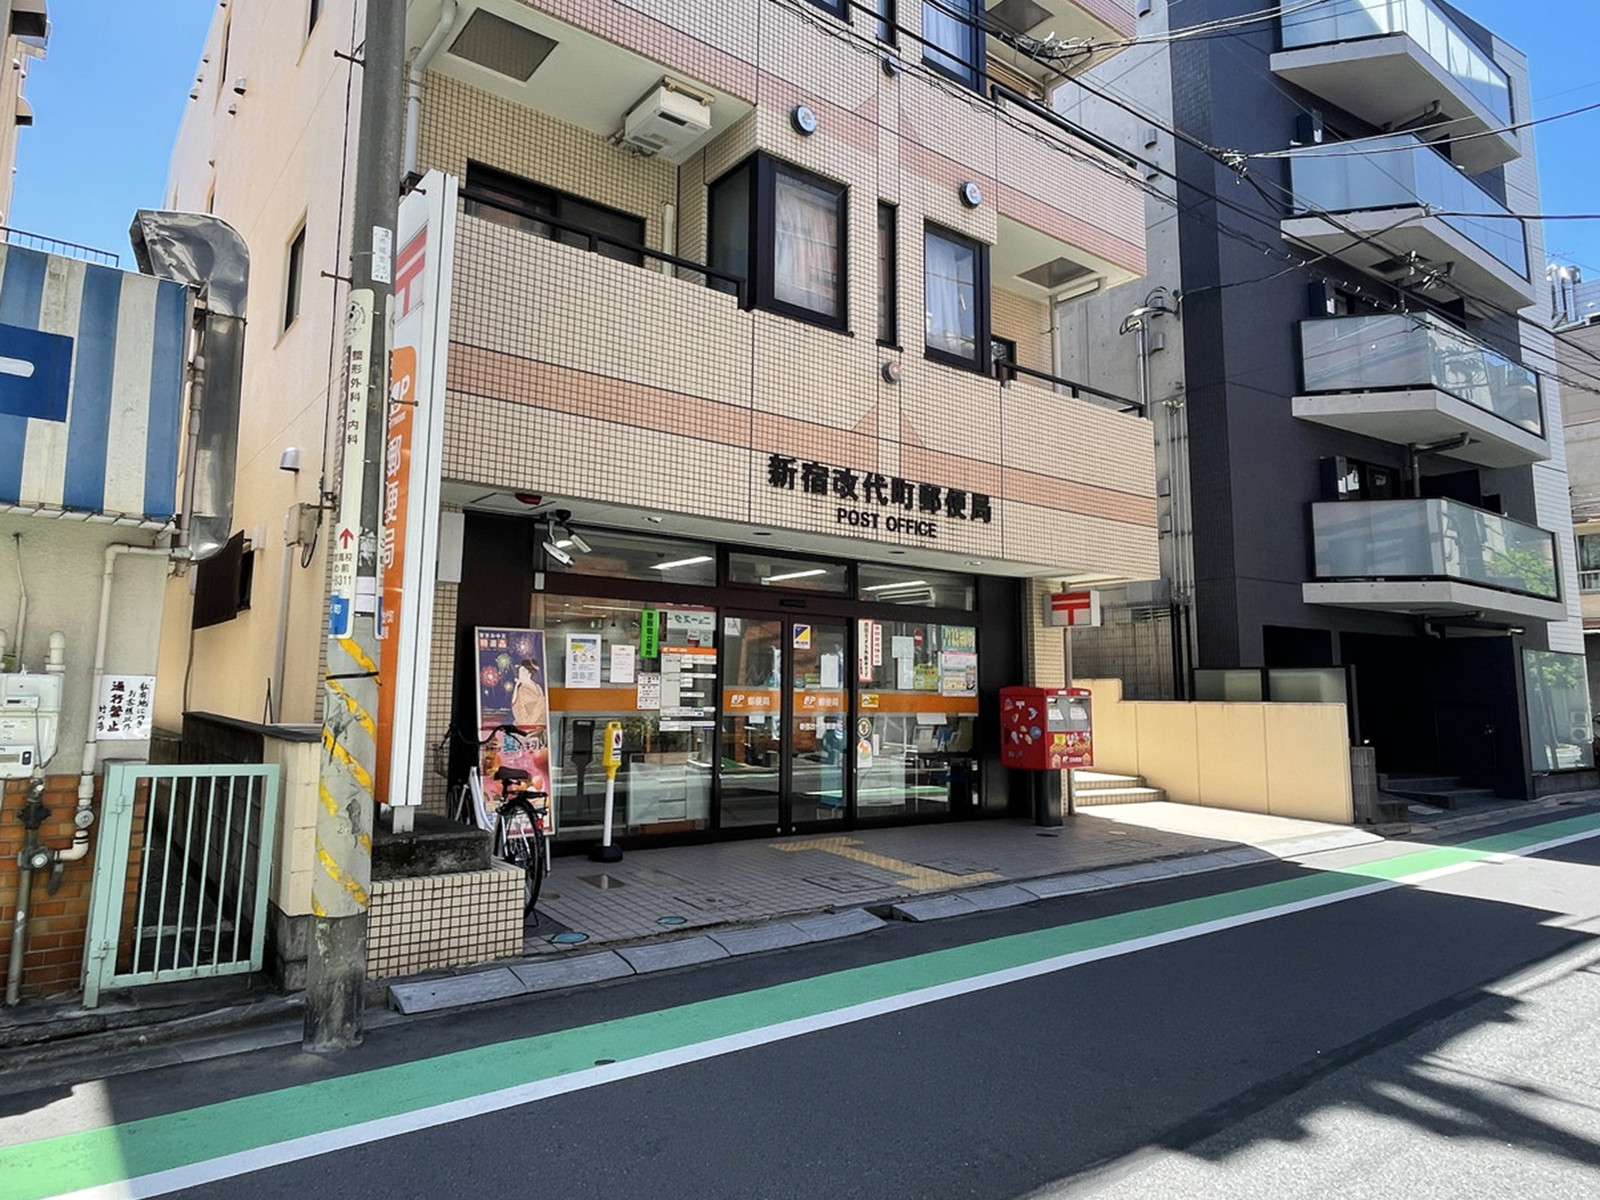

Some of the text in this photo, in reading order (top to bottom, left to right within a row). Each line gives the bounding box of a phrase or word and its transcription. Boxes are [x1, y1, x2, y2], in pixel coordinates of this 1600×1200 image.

[346, 350, 363, 445] 整形外科・内科
[768, 453, 991, 524] 新宿改代町郵便局
[837, 507, 938, 538] POST OFFICE
[107, 681, 125, 732] 通行禁止
